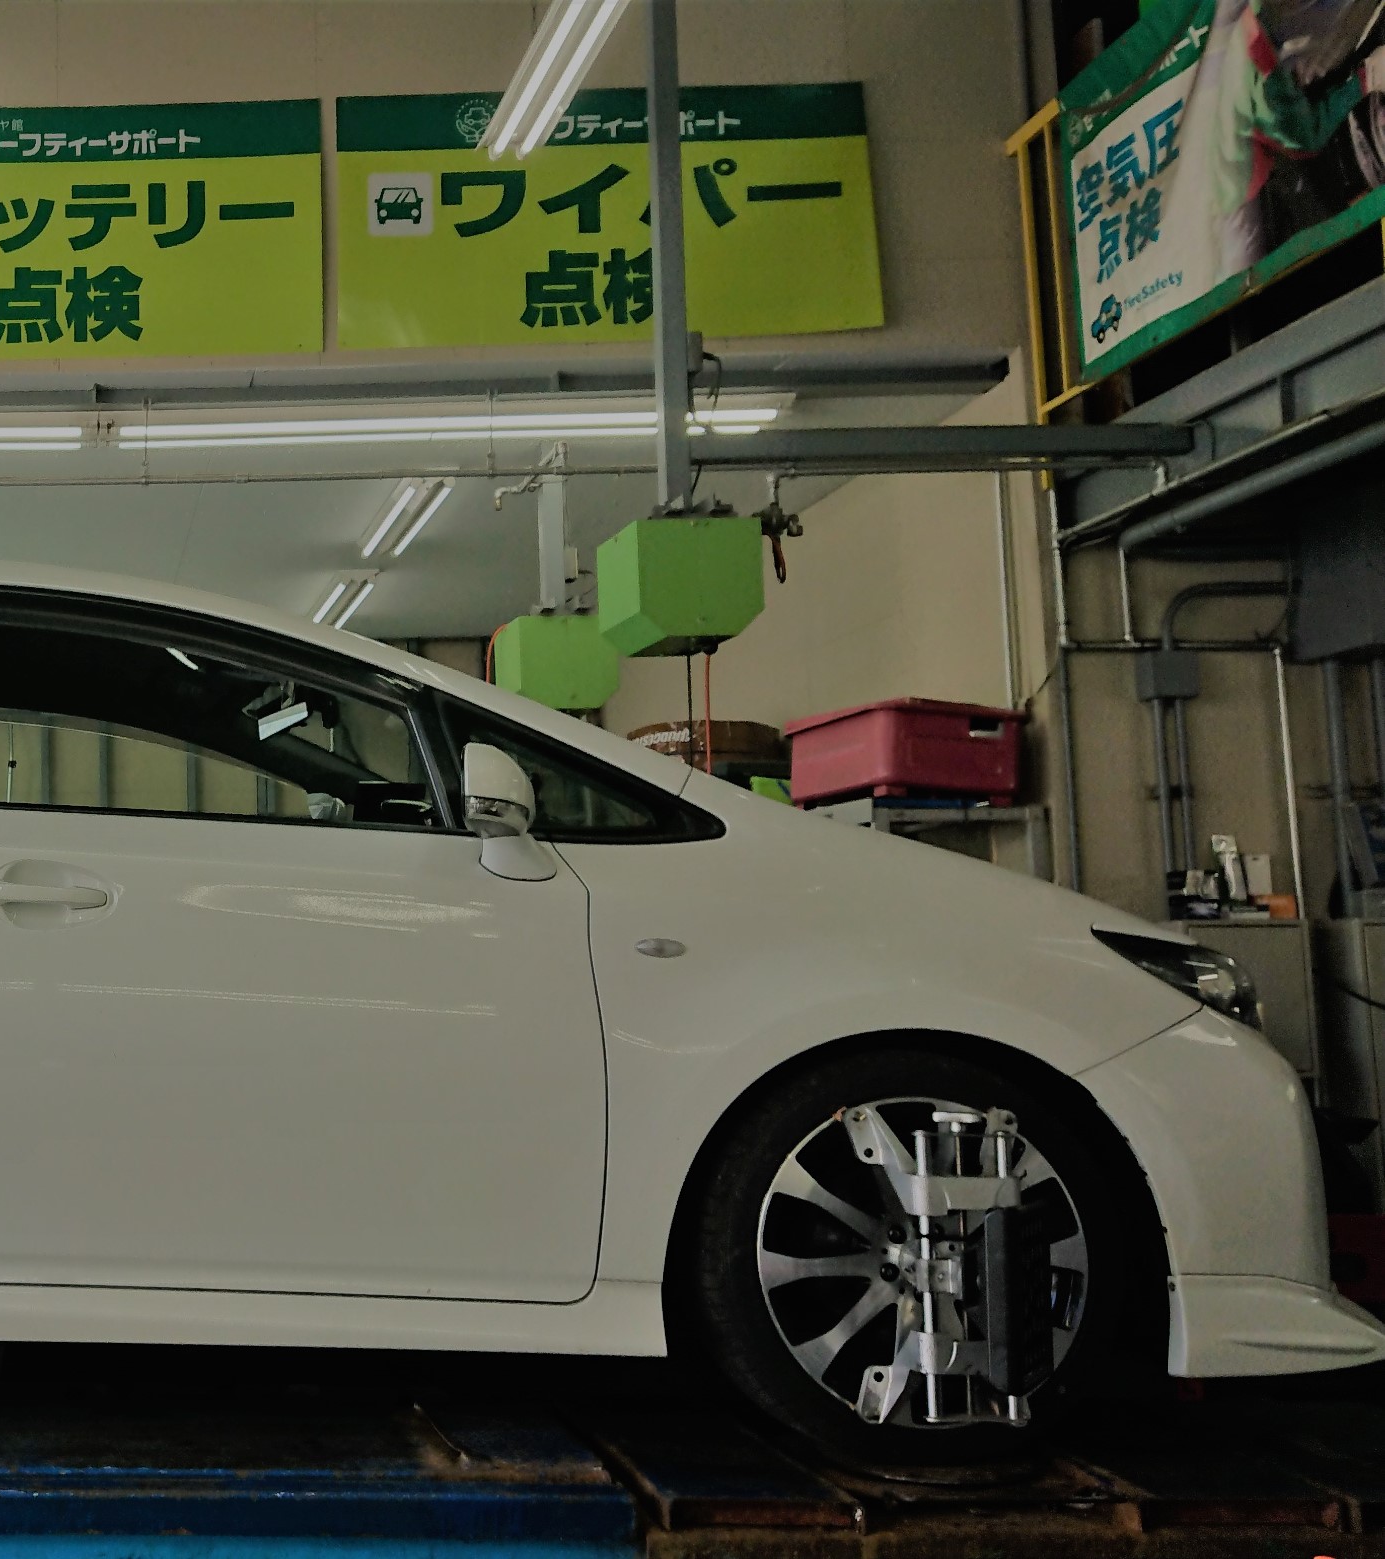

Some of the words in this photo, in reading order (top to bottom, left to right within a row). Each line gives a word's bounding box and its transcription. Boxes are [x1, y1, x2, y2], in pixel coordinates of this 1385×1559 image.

[553, 109, 741, 139] フティーポート
[440, 158, 842, 238] ワイパー
[1075, 98, 1185, 232] 空気圧
